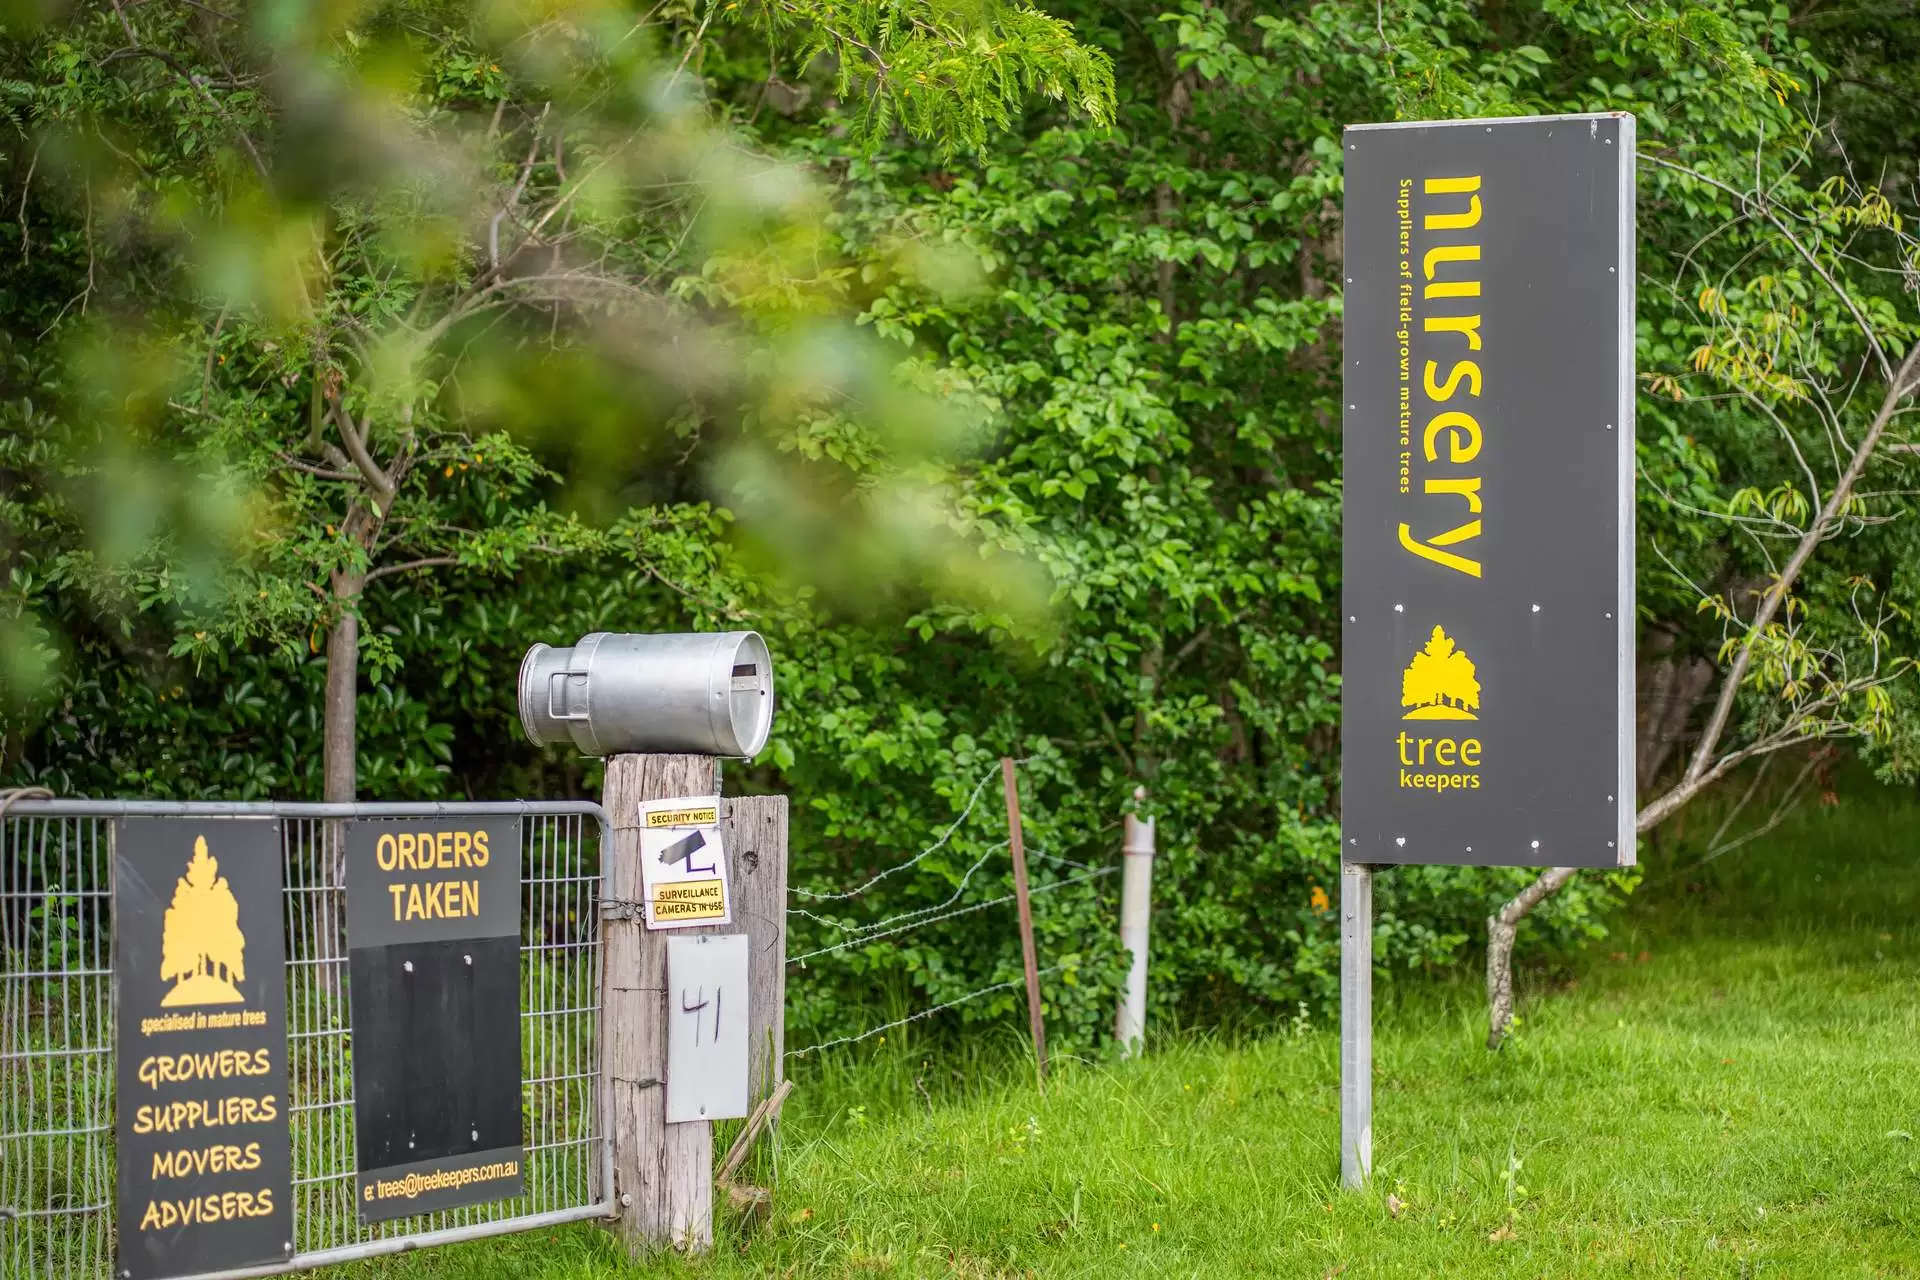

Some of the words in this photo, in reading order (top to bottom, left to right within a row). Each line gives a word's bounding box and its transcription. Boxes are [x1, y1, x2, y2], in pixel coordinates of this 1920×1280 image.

[1397, 178, 1413, 255] Suppliers
[1399, 260, 1413, 279] of
[1396, 282, 1414, 382] field-grown
[1397, 175, 1483, 579] nursery
[1399, 387, 1412, 447] mature
[1399, 451, 1412, 494] trees
[1395, 730, 1482, 767] tree
[1399, 768, 1481, 793] keepers
[651, 813, 691, 825] SECURITY
[693, 811, 715, 821] NOTICE
[376, 830, 490, 871] ORDERS
[388, 879, 480, 921] TAKEN
[655, 903, 697, 916] CAMERAS
[699, 903, 707, 912] IN
[709, 901, 723, 911] USE
[659, 887, 719, 901] SURVEILLANCE
[141, 1011, 196, 1036] specialised
[196, 1011, 207, 1029] in
[208, 1011, 241, 1028] mature
[242, 1009, 267, 1026] trees
[682, 985, 721, 1047] 41
[138, 1048, 270, 1090] GROWERS
[133, 1095, 277, 1134] SUPPLIERS
[151, 1142, 262, 1180] MOVERS
[364, 1184, 374, 1201] e:
[377, 1160, 518, 1199] trees@treekeepers.com.au
[140, 1188, 274, 1231] ADVISERS
